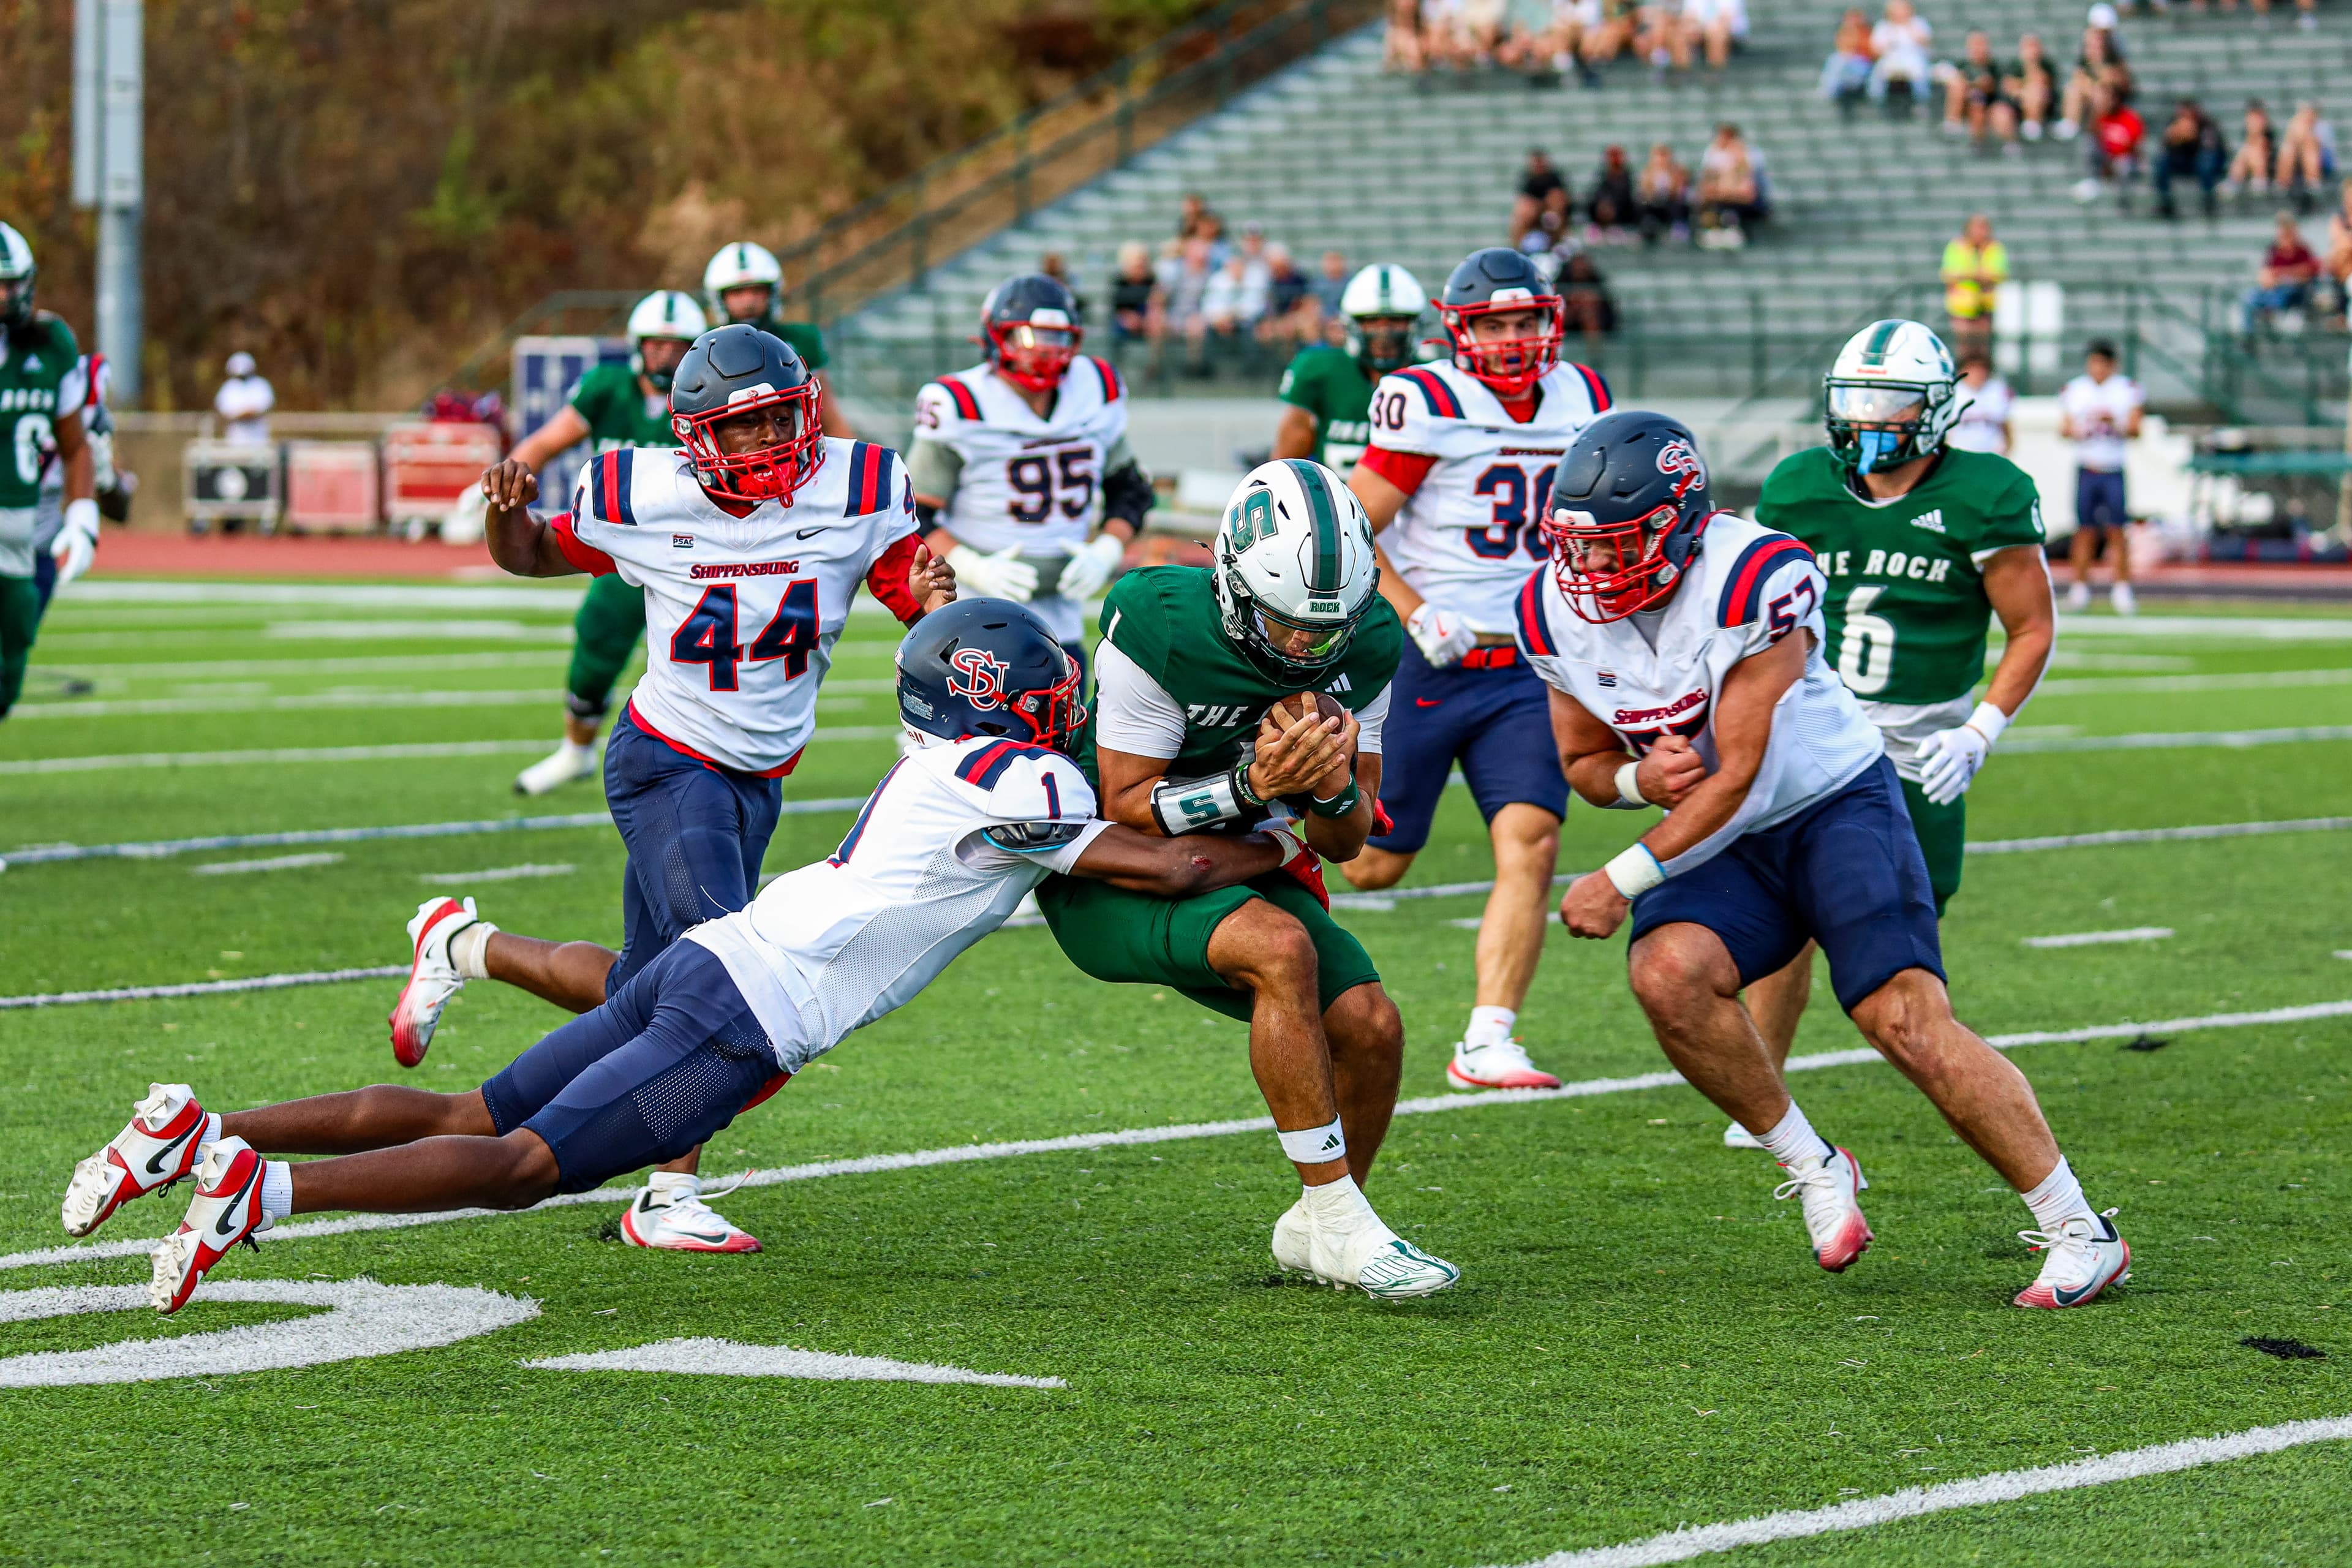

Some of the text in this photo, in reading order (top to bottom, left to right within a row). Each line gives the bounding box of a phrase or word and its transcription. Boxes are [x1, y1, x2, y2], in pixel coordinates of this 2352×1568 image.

[1008, 447, 1094, 524] 95
[690, 560, 799, 579] SHIPPENSBURG
[1814, 549, 1952, 582] HE ROCK
[1309, 601, 1340, 613] ROCK
[1768, 574, 1816, 644] 57
[669, 577, 821, 692] 44
[1839, 584, 1897, 695] 6
[1186, 703, 1248, 727] THE
[1041, 771, 1061, 820] 1
